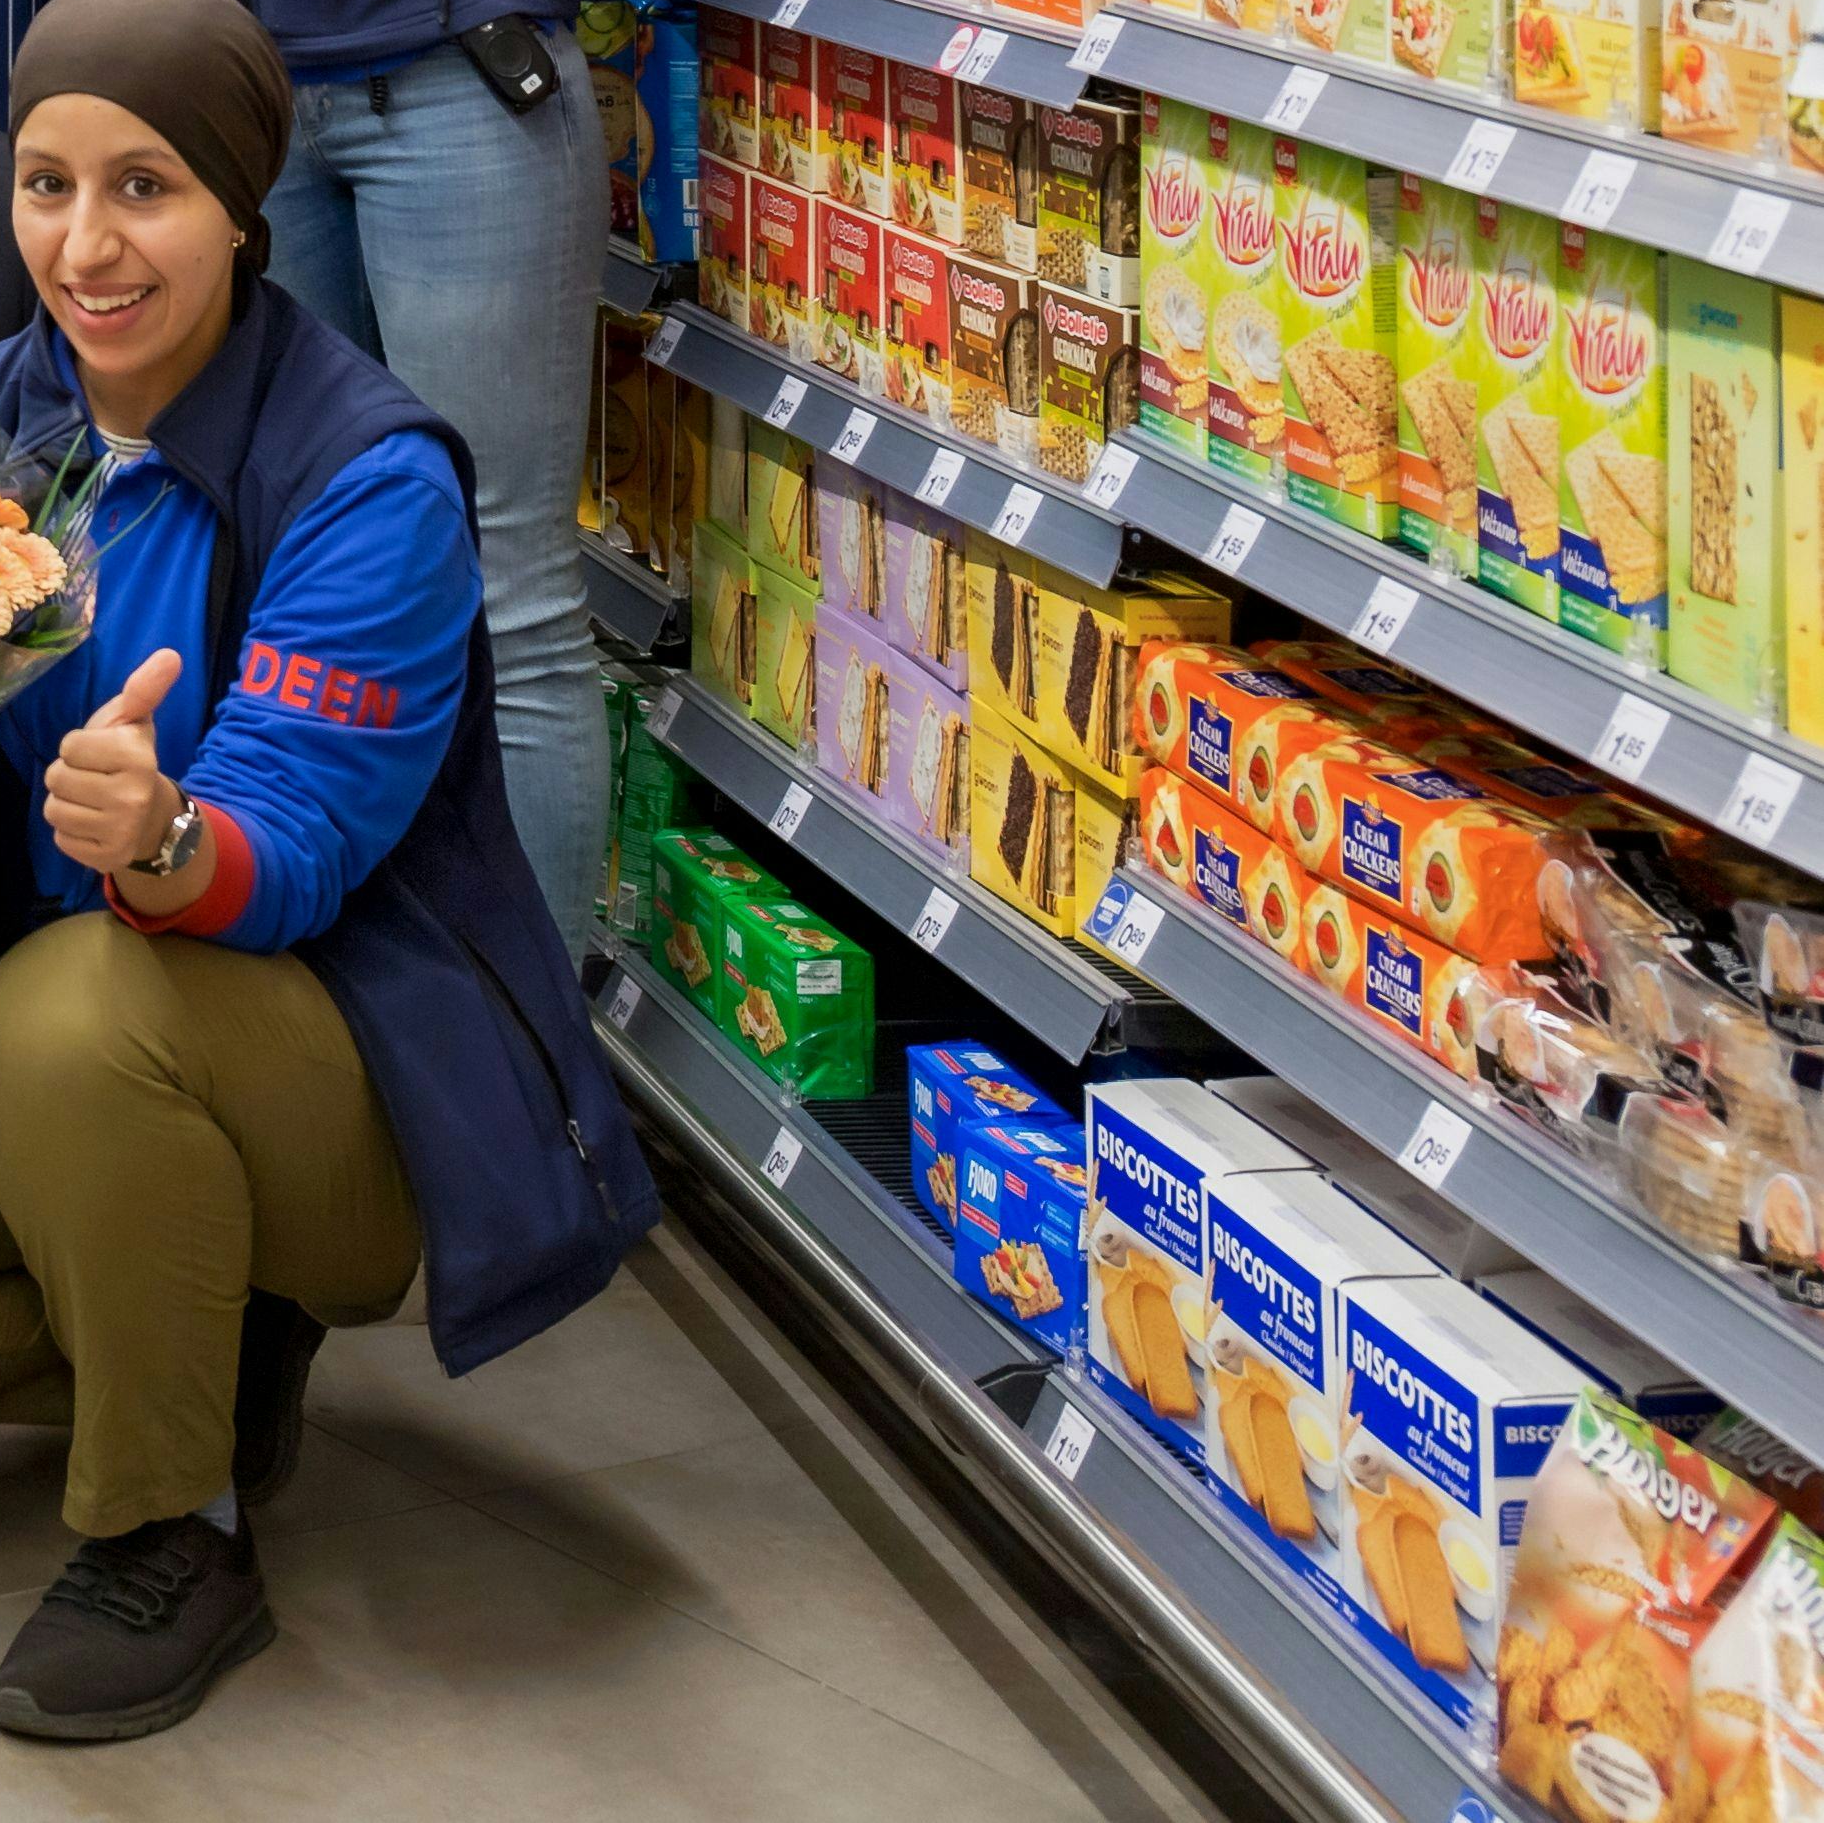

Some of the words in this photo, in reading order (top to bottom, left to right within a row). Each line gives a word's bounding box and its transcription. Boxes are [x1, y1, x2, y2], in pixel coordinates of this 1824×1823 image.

[1054, 110, 1103, 148] Bolletje
[1279, 216, 1362, 294] Vitalu
[963, 275, 1005, 311] Bolletje
[1056, 303, 1109, 344] Bolletje
[1564, 301, 1649, 391] Vitalu
[1209, 395, 1245, 430] Volkoren
[925, 474, 950, 496] 1.70
[1098, 472, 1121, 497] 1.70
[1003, 508, 1026, 532] 1.70
[1214, 532, 1246, 562] 1.55
[1041, 632, 1064, 652] gwoon
[1363, 611, 1398, 641] 1.45
[242, 642, 399, 729] DEEN
[1198, 715, 1223, 748] CREAM
[1612, 731, 1648, 766] 1.85
[1189, 730, 1231, 775] CRACKERS
[973, 772, 998, 795] gwoon
[1735, 793, 1777, 831] 1.85
[1078, 829, 1104, 854] gwoon
[1354, 819, 1389, 853] CREAM
[1342, 835, 1402, 885] CRACKERS
[916, 913, 941, 941] 0.75
[1119, 922, 1146, 950] 0.89
[1378, 950, 1413, 987] CREAM
[1366, 965, 1423, 1017] CRACKERS
[914, 1077, 934, 1118] FJORD
[1414, 1136, 1452, 1170] 0.95
[967, 1158, 998, 1203] FJORD
[1098, 1124, 1200, 1224] BISCOTTES
[1143, 1200, 1157, 1218] au
[1156, 1207, 1198, 1249] froment
[1212, 1221, 1316, 1335] BISCOTTES
[1259, 1307, 1274, 1327] au
[1273, 1315, 1315, 1360] froment
[1352, 1328, 1473, 1454] BISCOTTES
[1057, 1435, 1081, 1466] 1.10
[1406, 1423, 1423, 1443] au
[1422, 1429, 1471, 1481] froment
